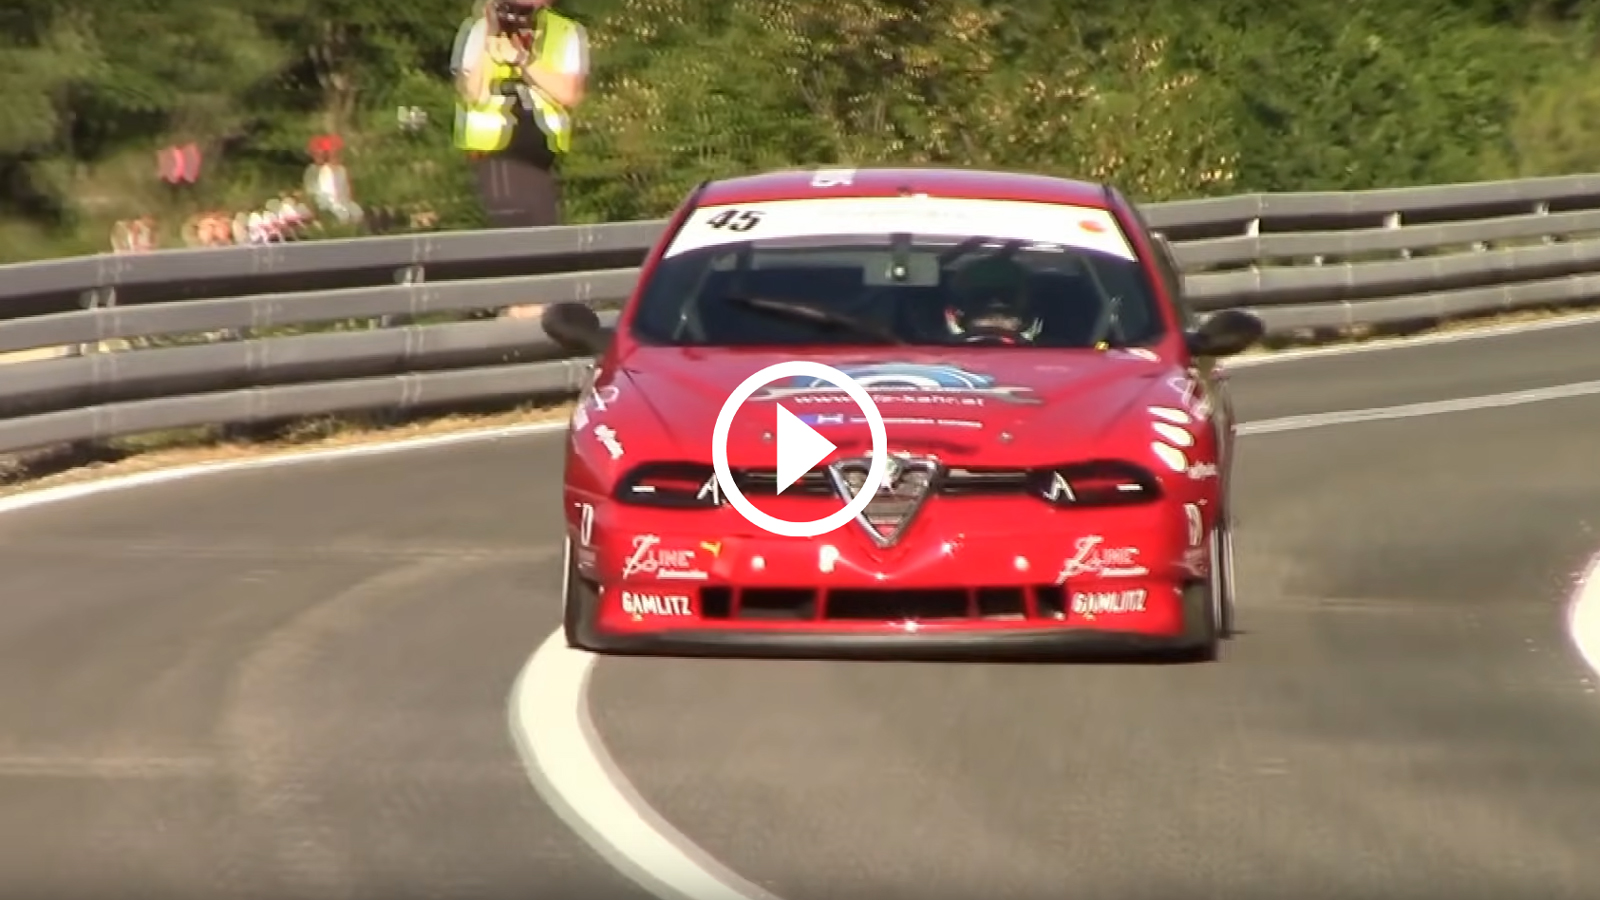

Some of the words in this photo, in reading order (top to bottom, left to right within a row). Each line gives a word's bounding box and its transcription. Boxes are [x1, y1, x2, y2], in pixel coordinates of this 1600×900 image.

[707, 209, 765, 232] 45
[621, 590, 691, 615] GAMLITZ
[1071, 588, 1148, 614] GAMLITZ
